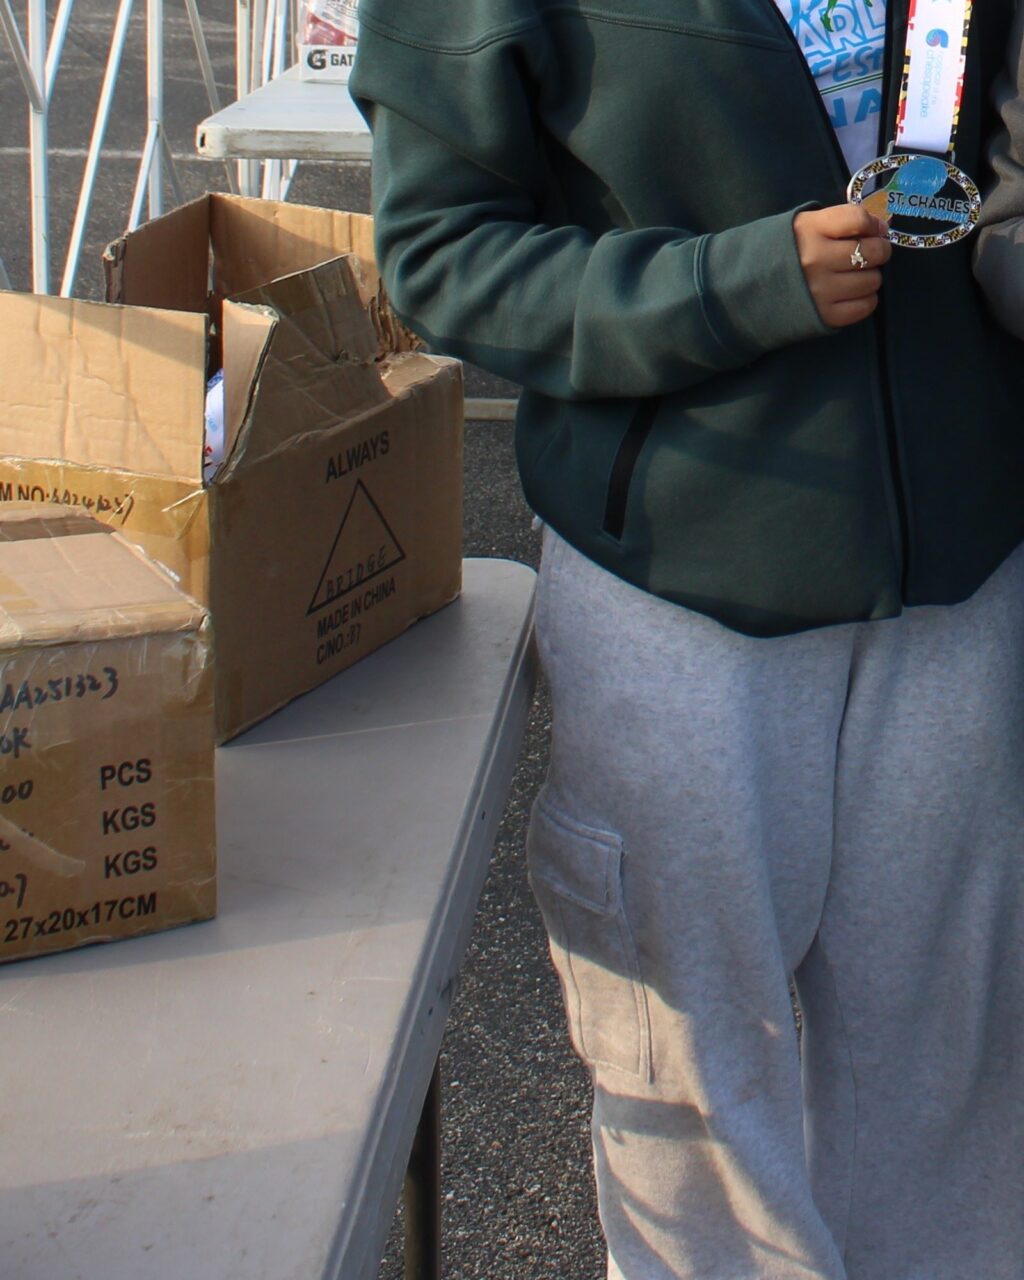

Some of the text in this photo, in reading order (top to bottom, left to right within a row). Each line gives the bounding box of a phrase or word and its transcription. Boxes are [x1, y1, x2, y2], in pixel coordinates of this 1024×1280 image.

[888, 191, 970, 214] ST. CHARLES
[326, 430, 390, 483] ALWAYS
[317, 576, 396, 639] MADE IN CHINA
[100, 758, 152, 791] PCS
[103, 802, 156, 836] KGS
[104, 846, 158, 879] KGS
[4, 892, 157, 944] 27x20x17CM
